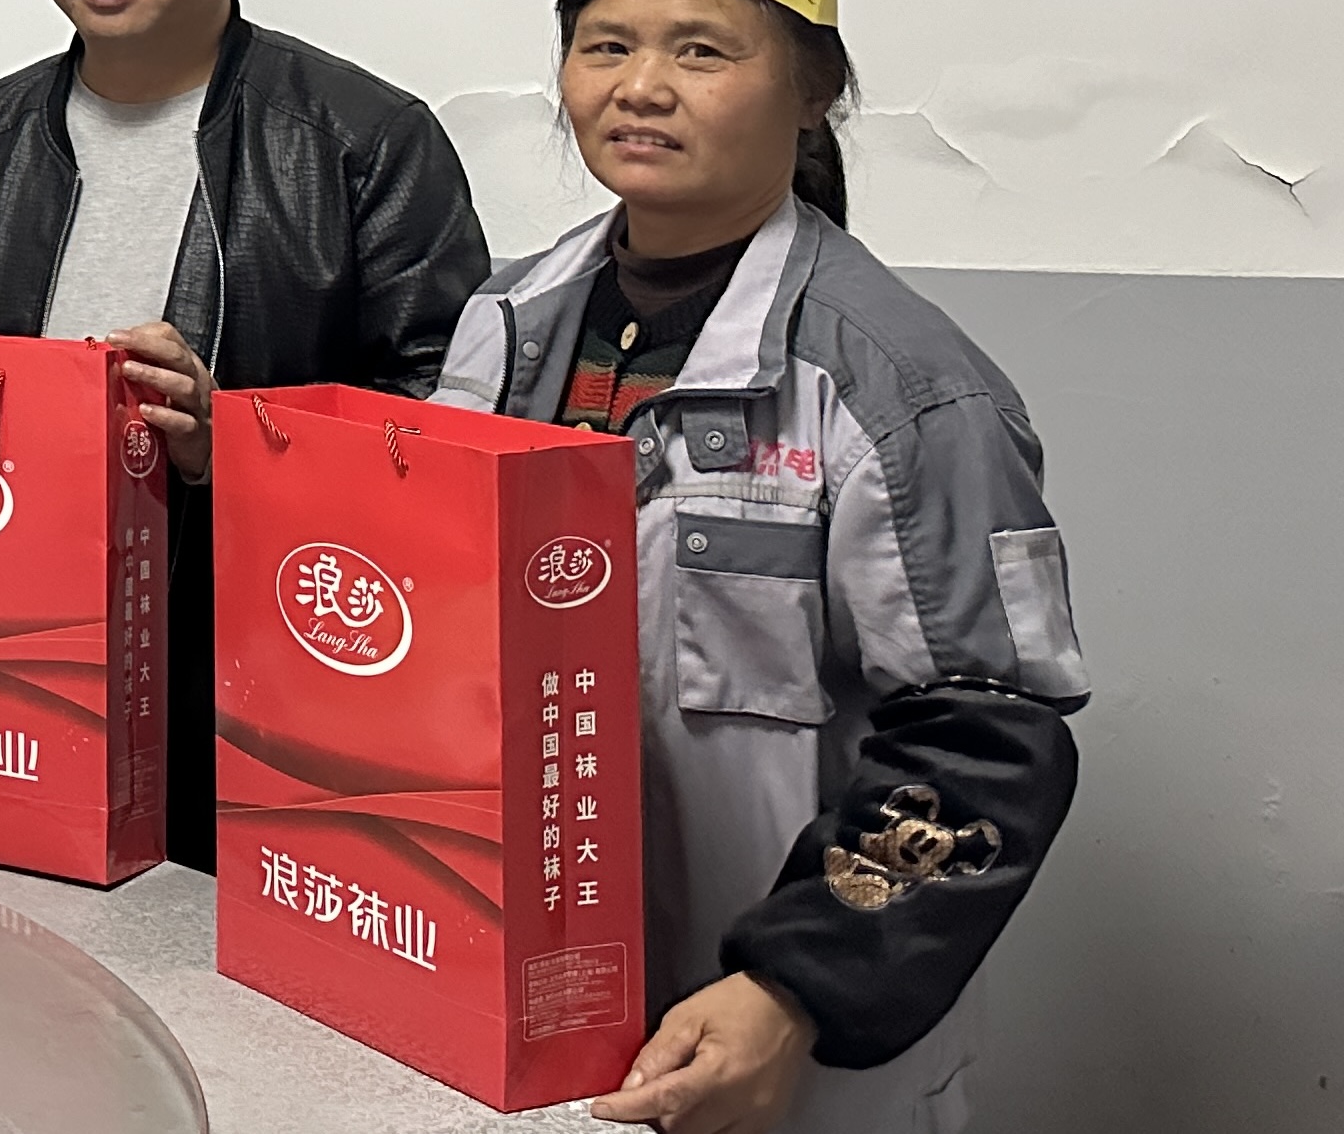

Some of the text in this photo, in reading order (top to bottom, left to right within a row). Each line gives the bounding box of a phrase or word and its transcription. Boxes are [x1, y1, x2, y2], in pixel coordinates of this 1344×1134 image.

[139, 525, 151, 717] 中国袜业大王
[294, 553, 385, 628] 浪莎
[538, 544, 594, 584] 浪莎
[541, 670, 561, 912] 做中国最好的袜子
[575, 668, 600, 907] 中国袜业大王
[261, 845, 437, 972] 浪莎袜业
